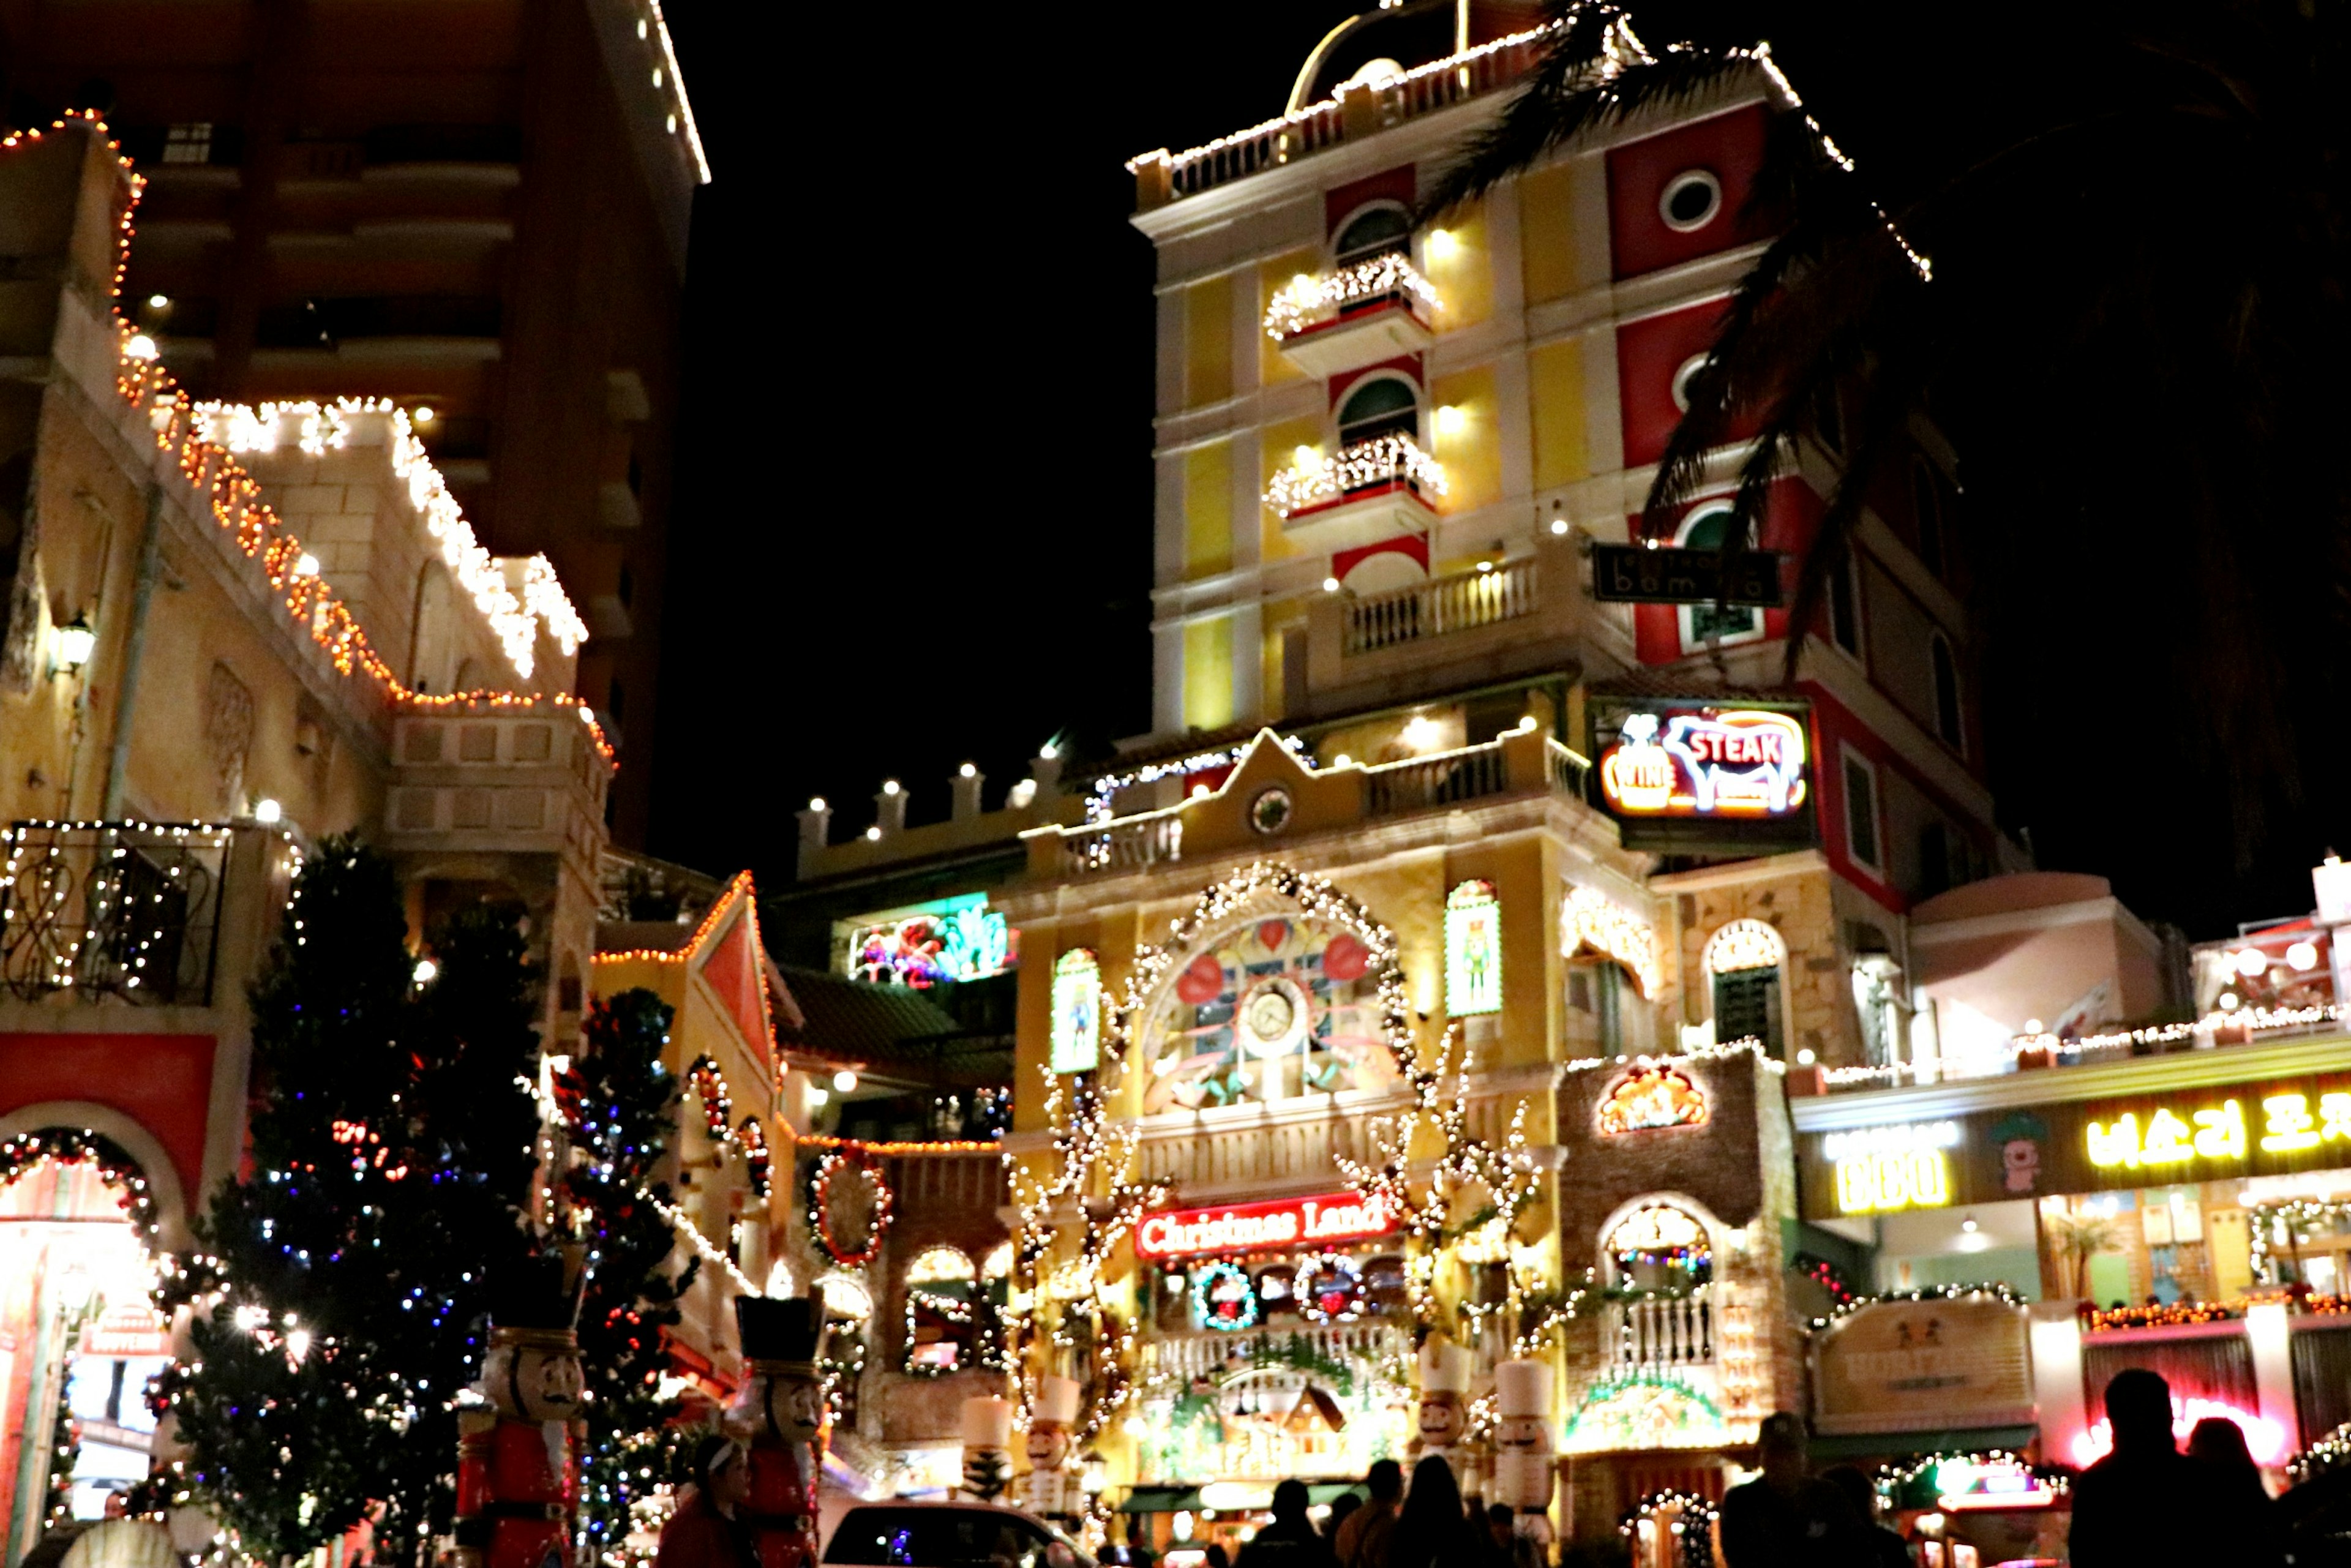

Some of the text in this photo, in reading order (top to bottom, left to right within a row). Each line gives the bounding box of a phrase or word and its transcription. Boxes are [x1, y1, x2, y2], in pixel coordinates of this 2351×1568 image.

[1690, 731, 1781, 763] STEAK
[1614, 763, 1677, 789] WINE
[1837, 1151, 1949, 1212] BBQ
[1141, 1193, 1386, 1253] Christmas Land
